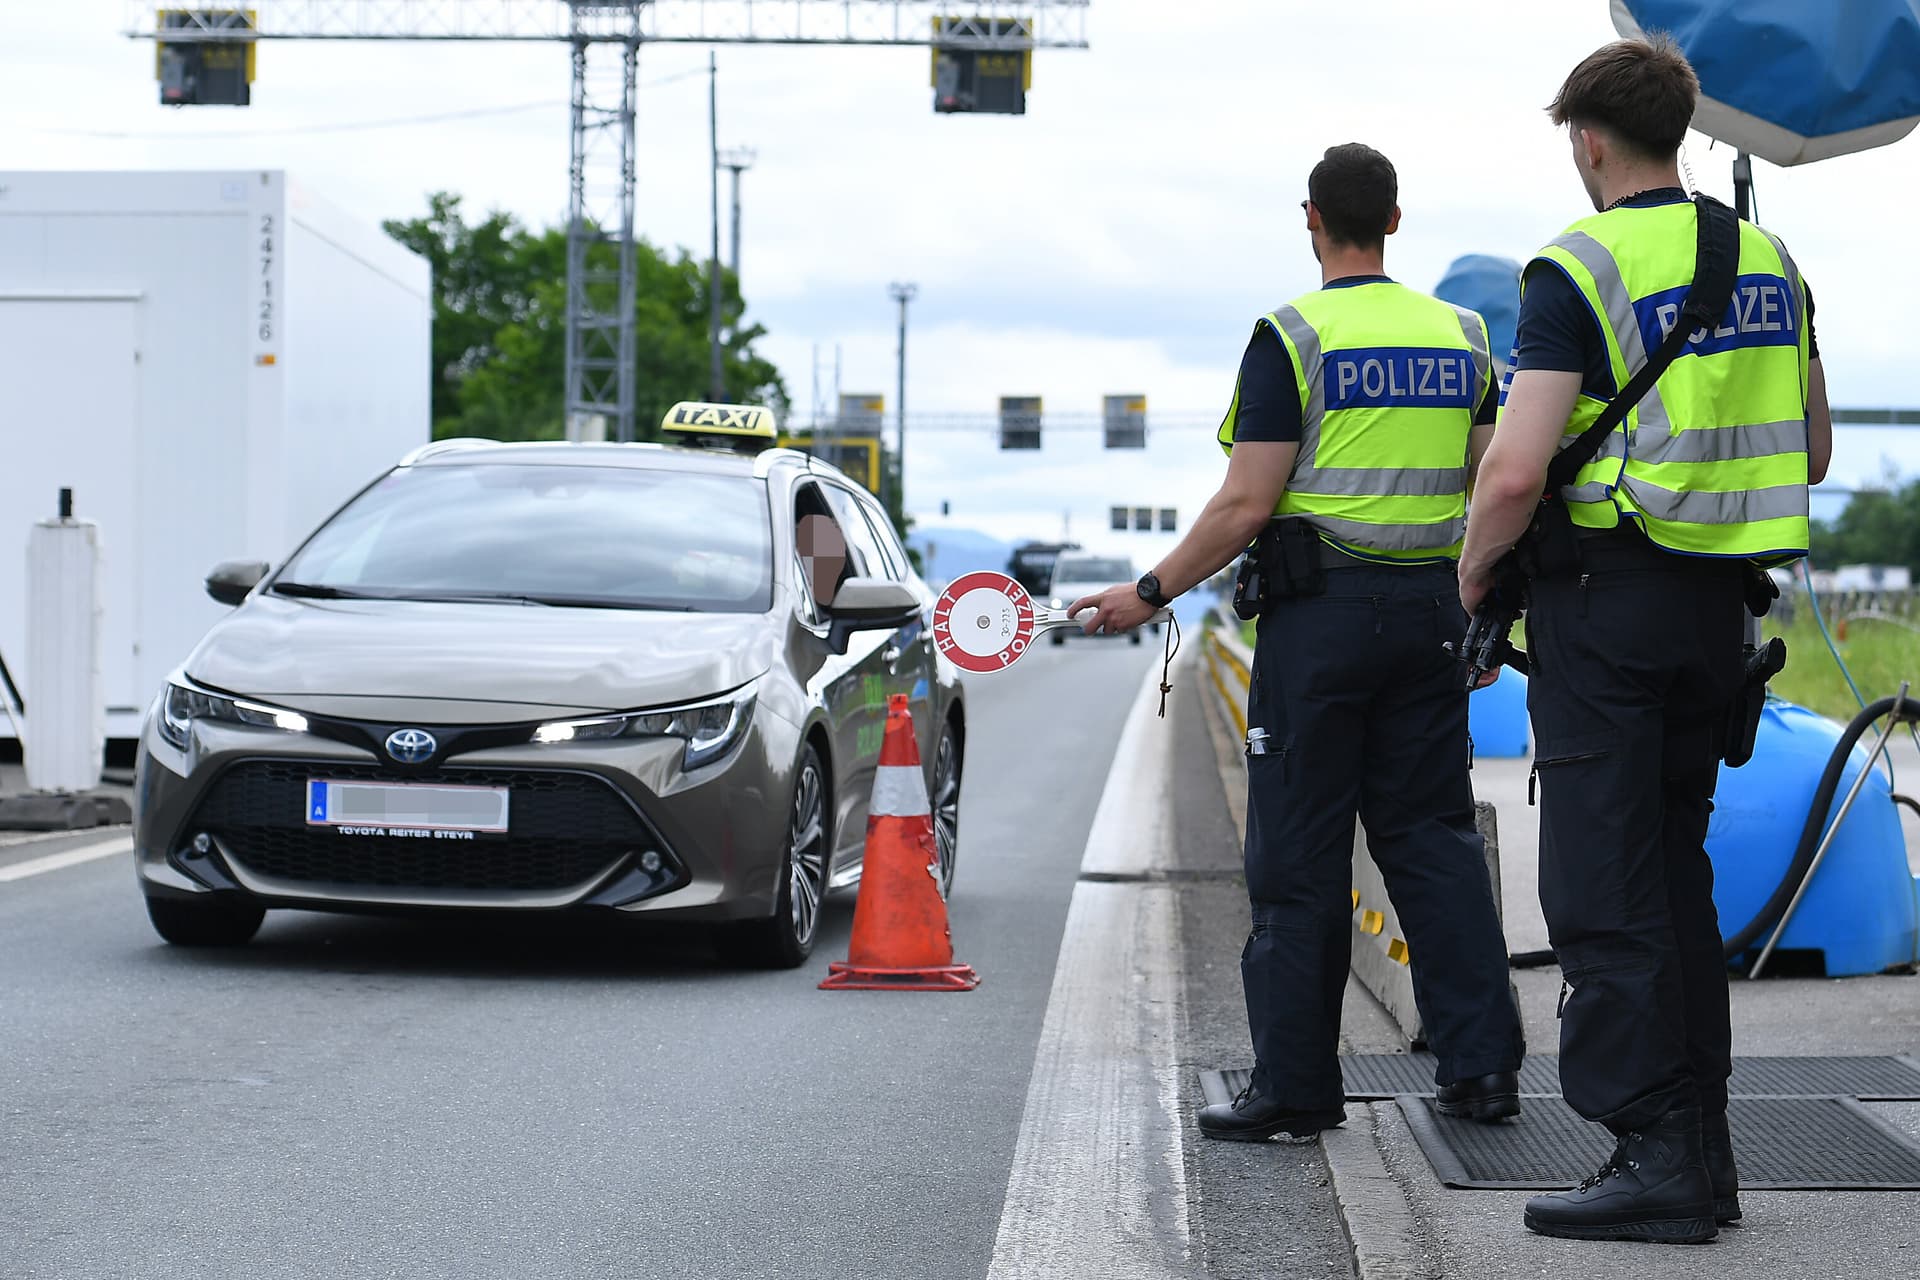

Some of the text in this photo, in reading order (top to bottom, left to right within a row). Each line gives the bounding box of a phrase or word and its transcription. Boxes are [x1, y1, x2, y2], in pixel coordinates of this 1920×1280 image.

[259, 213, 274, 342] 247126
[1337, 358, 1467, 400] POLIZEI
[679, 407, 760, 430] TAXI
[934, 590, 957, 653] HALT
[998, 581, 1034, 666] POLIZEI
[314, 806, 323, 816] A
[337, 826, 474, 840] TOYOTA REITER STEYR
